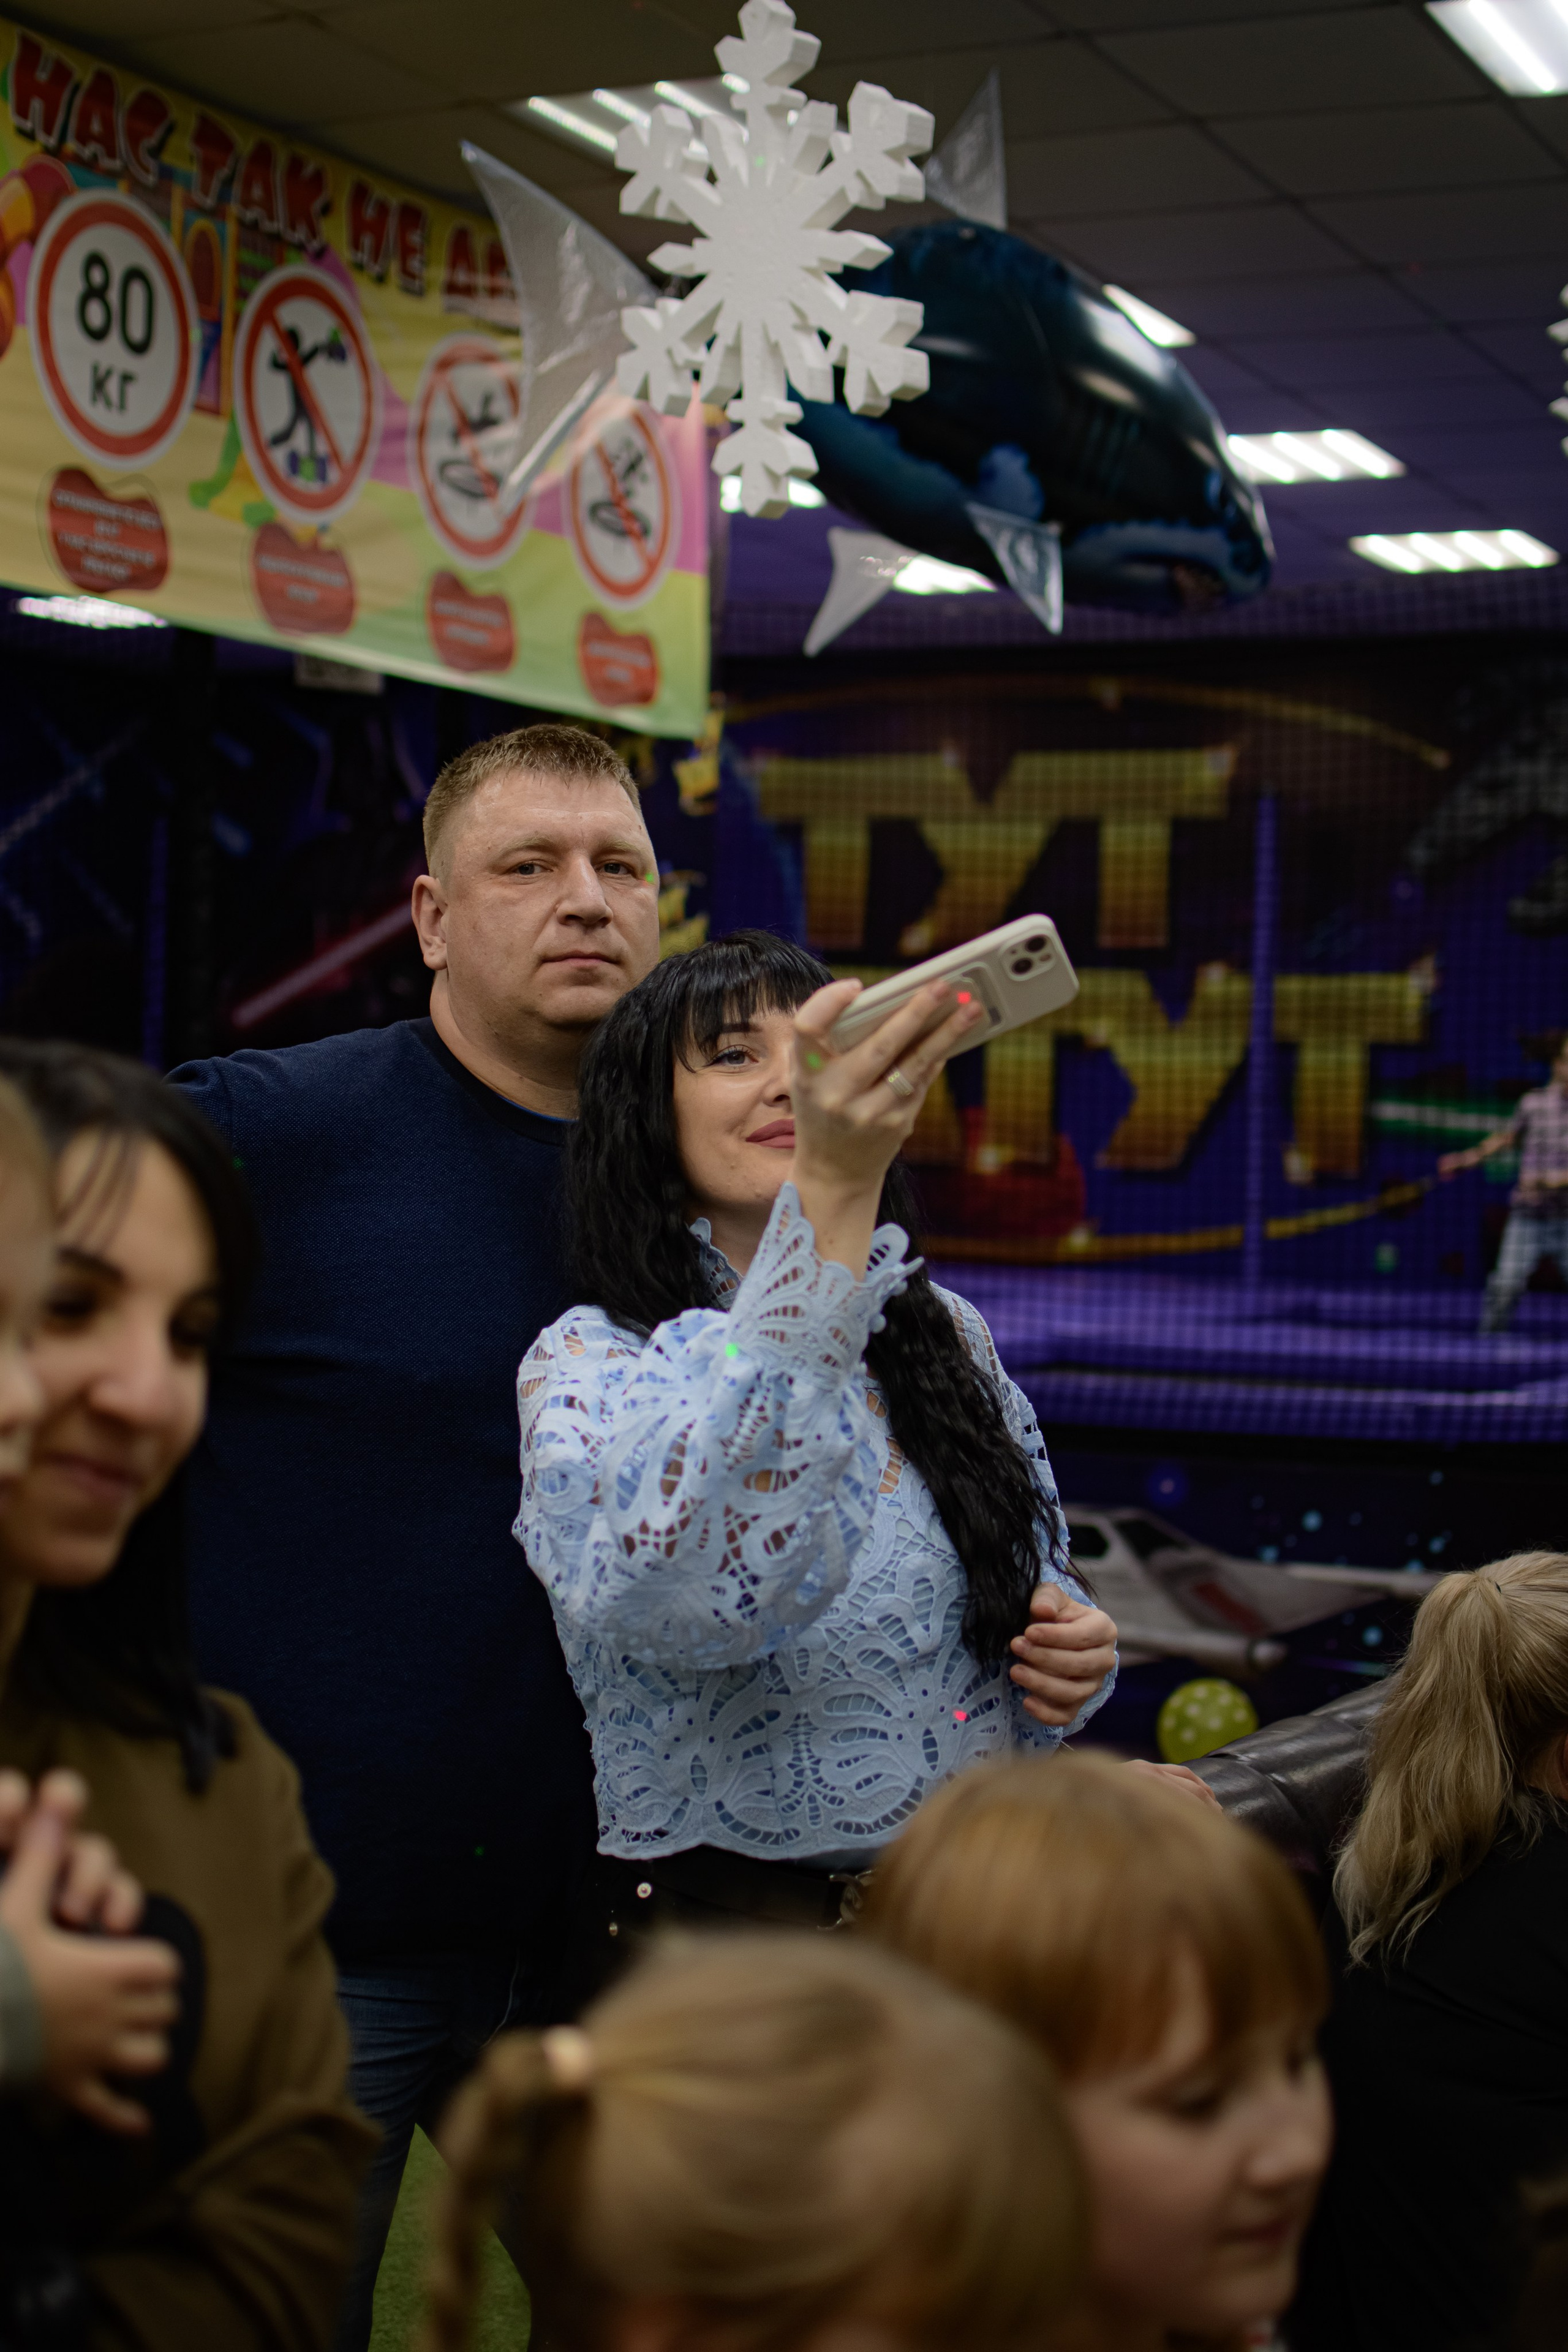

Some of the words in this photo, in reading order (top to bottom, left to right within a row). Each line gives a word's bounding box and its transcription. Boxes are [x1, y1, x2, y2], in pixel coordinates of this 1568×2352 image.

[9, 28, 174, 186] НАС
[190, 107, 330, 251] ТАК
[347, 176, 429, 294] НЕ
[77, 250, 155, 355] 80
[756, 746, 1232, 949] ТУТ
